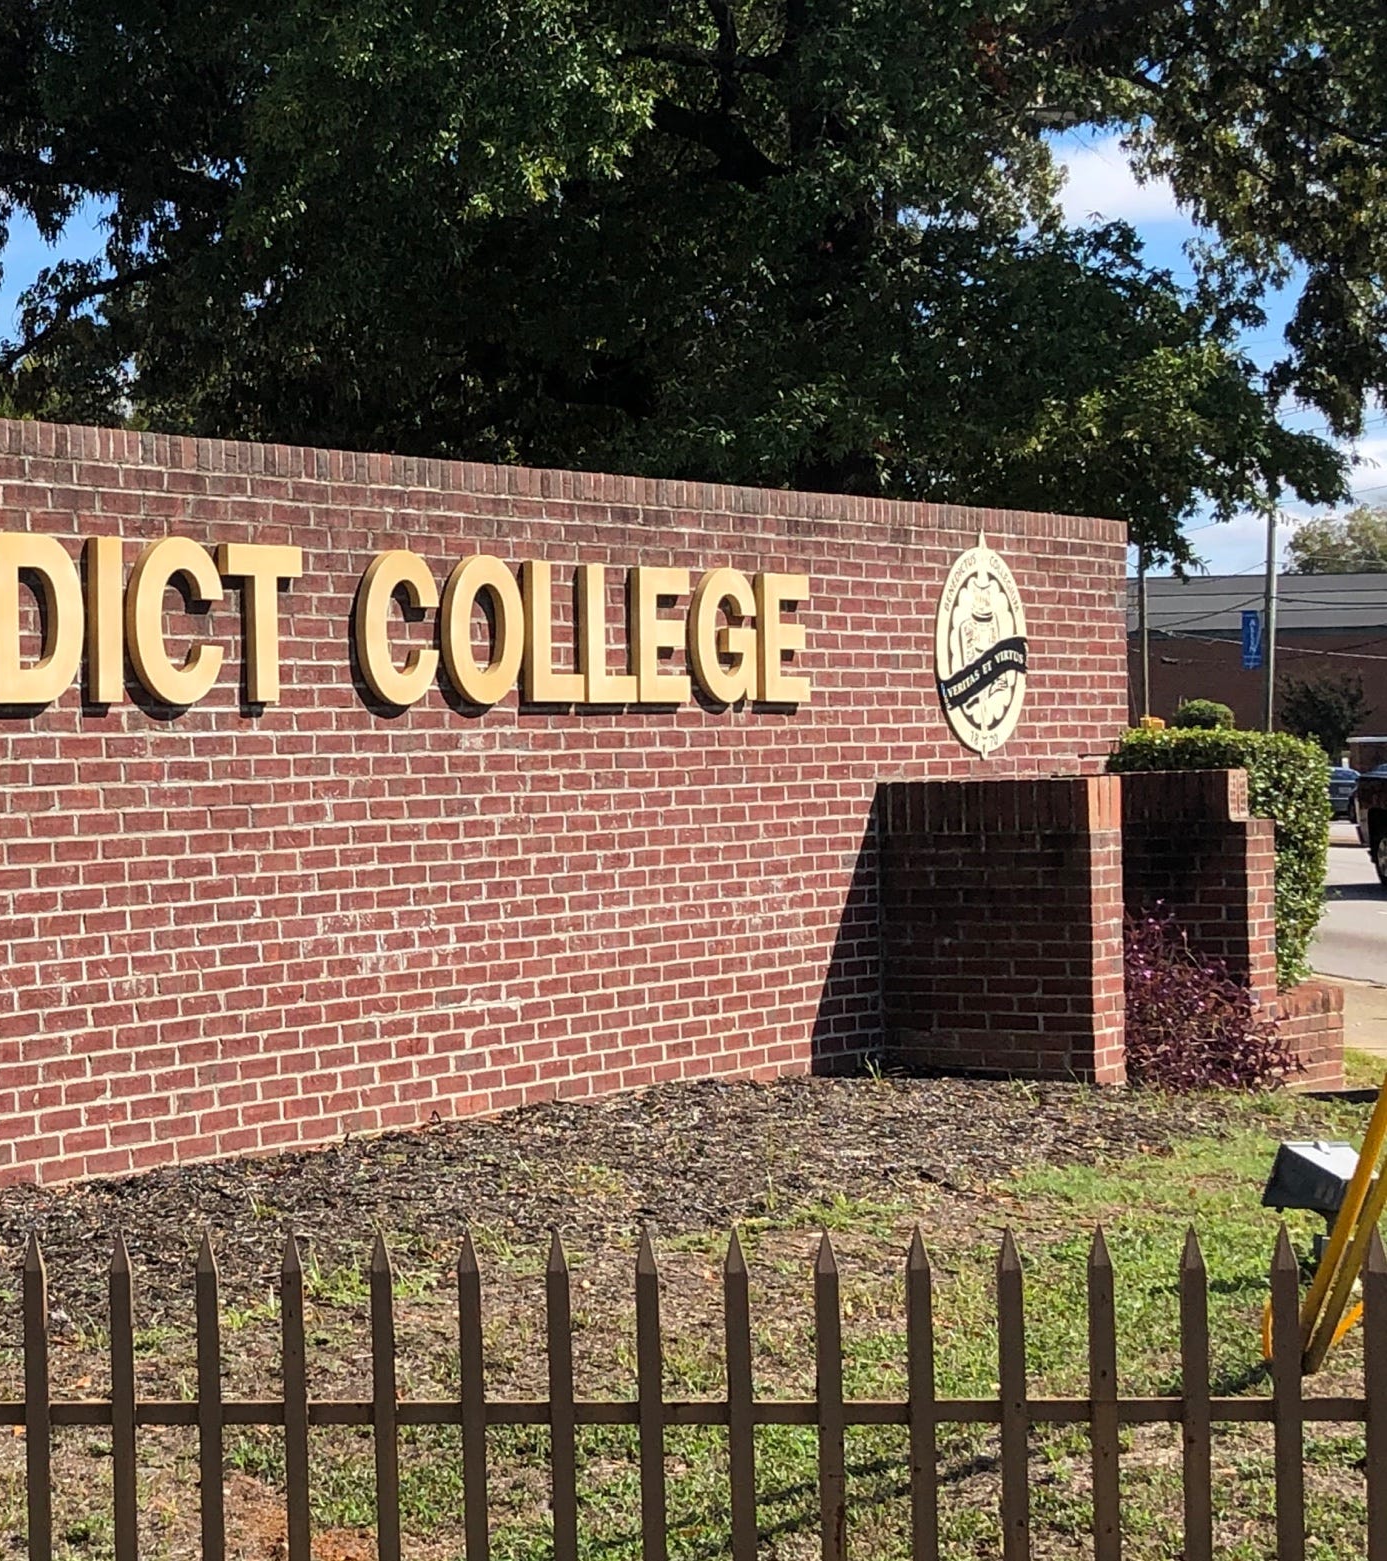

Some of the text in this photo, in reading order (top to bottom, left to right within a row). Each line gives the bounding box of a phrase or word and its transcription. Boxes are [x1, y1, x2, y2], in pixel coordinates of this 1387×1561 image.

[356, 549, 812, 706] COLLEGE
[947, 649, 1024, 698] VERITAS ET VIRTUS
